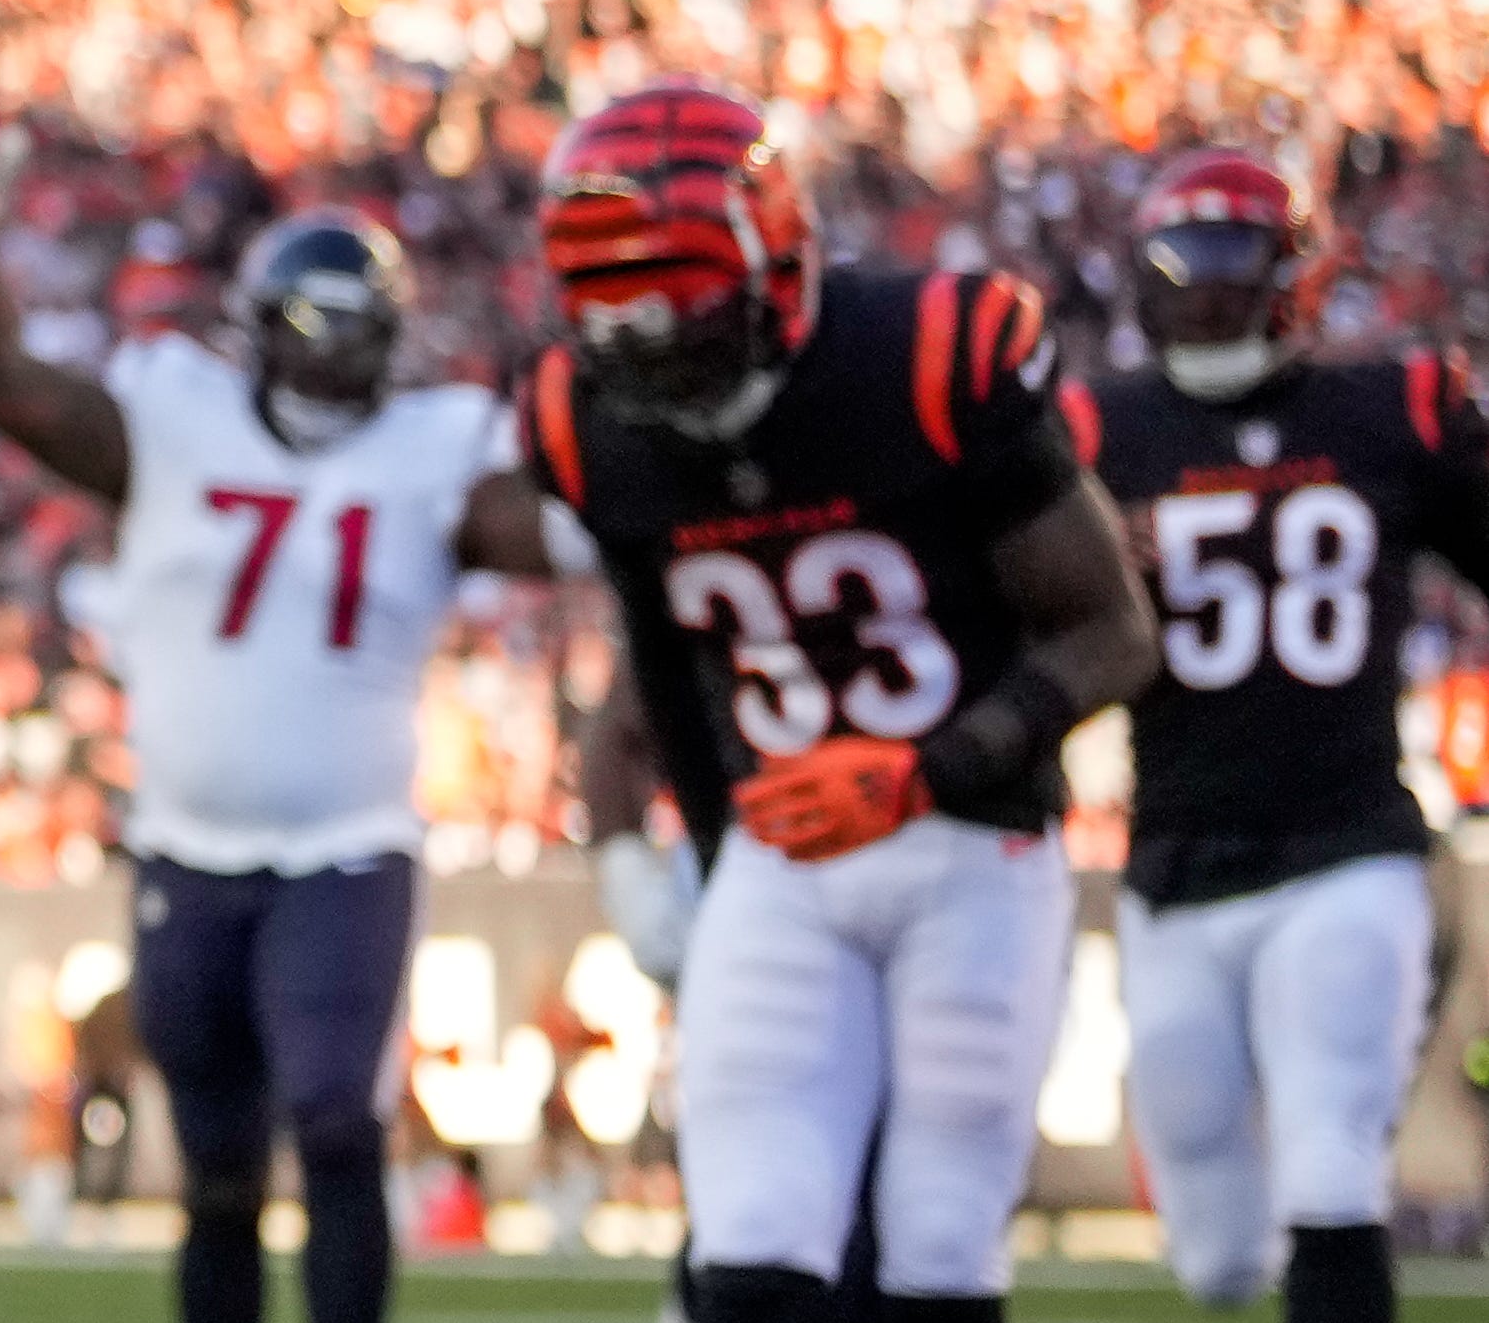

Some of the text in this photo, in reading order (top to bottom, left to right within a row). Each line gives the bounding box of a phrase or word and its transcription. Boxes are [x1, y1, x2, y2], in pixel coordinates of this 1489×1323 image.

[202, 486, 373, 649] 71
[662, 529, 962, 759] 33
[1152, 482, 1378, 691] 58
